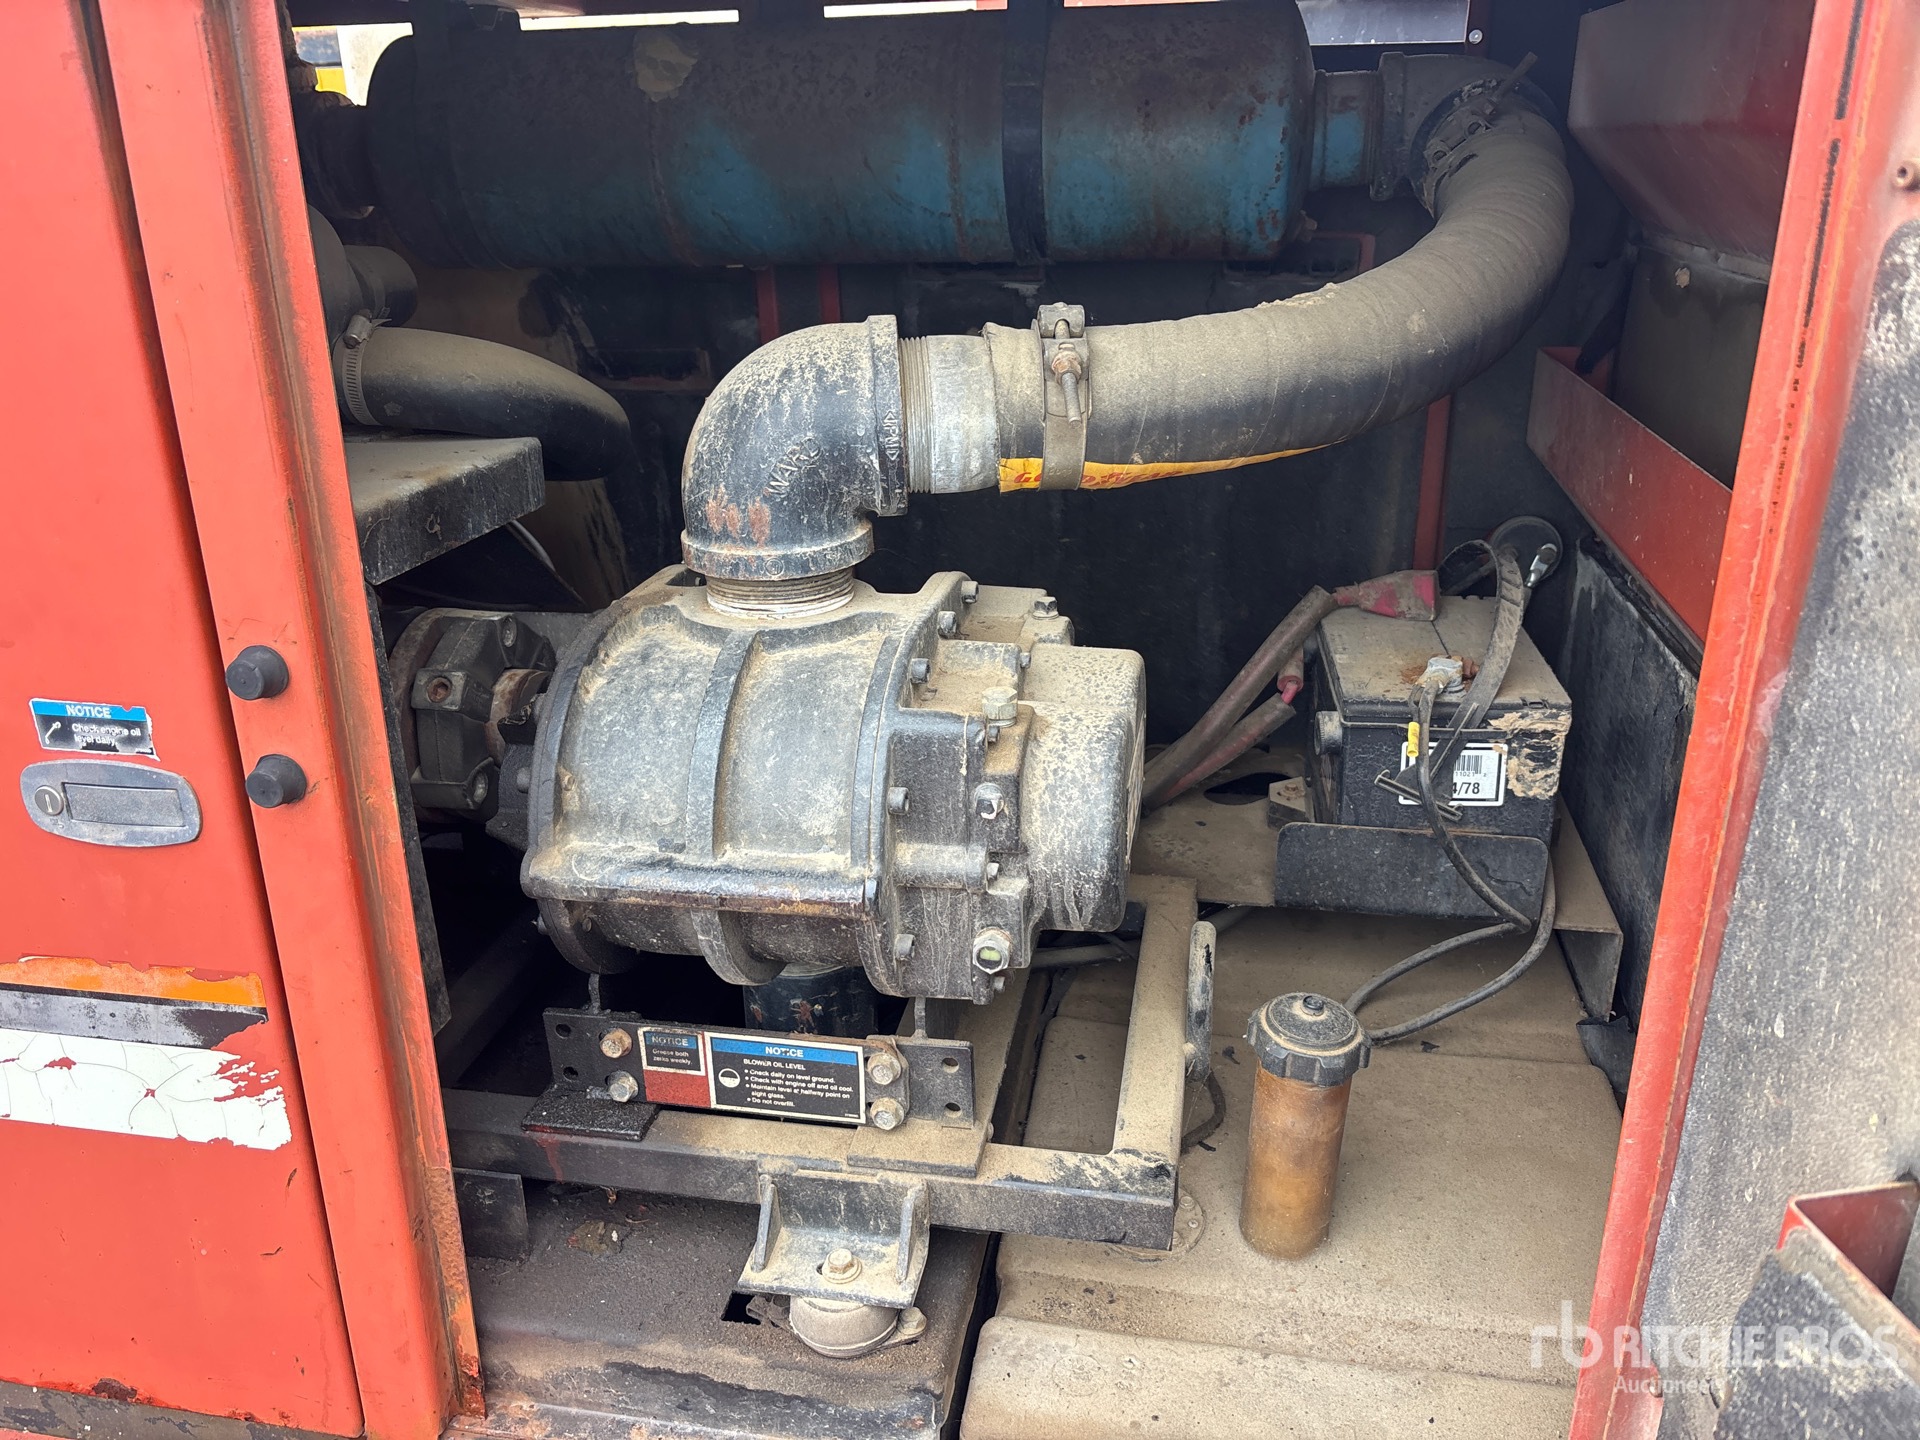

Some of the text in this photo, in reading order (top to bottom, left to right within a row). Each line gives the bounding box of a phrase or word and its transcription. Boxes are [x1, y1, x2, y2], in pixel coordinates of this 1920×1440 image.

[66, 705, 112, 718] NOTICE
[72, 723, 141, 737] Check engine oil
[74, 734, 94, 744] level
[652, 1036, 688, 1046] NOTICE
[765, 1046, 804, 1058] NOTICE
[743, 1058, 772, 1067] BLOWER
[750, 1076, 770, 1084] Check
[785, 1079, 806, 1088] engine
[807, 1080, 816, 1088] off
[816, 1082, 828, 1090] and
[770, 1070, 786, 1079] daily
[796, 1073, 810, 1081] level
[812, 1076, 836, 1084] ground.
[750, 1083, 776, 1091] Maintain
[800, 1088, 824, 1097] halfway
[751, 1090, 786, 1100] sight glass.
[774, 1099, 796, 1107] overfill.
